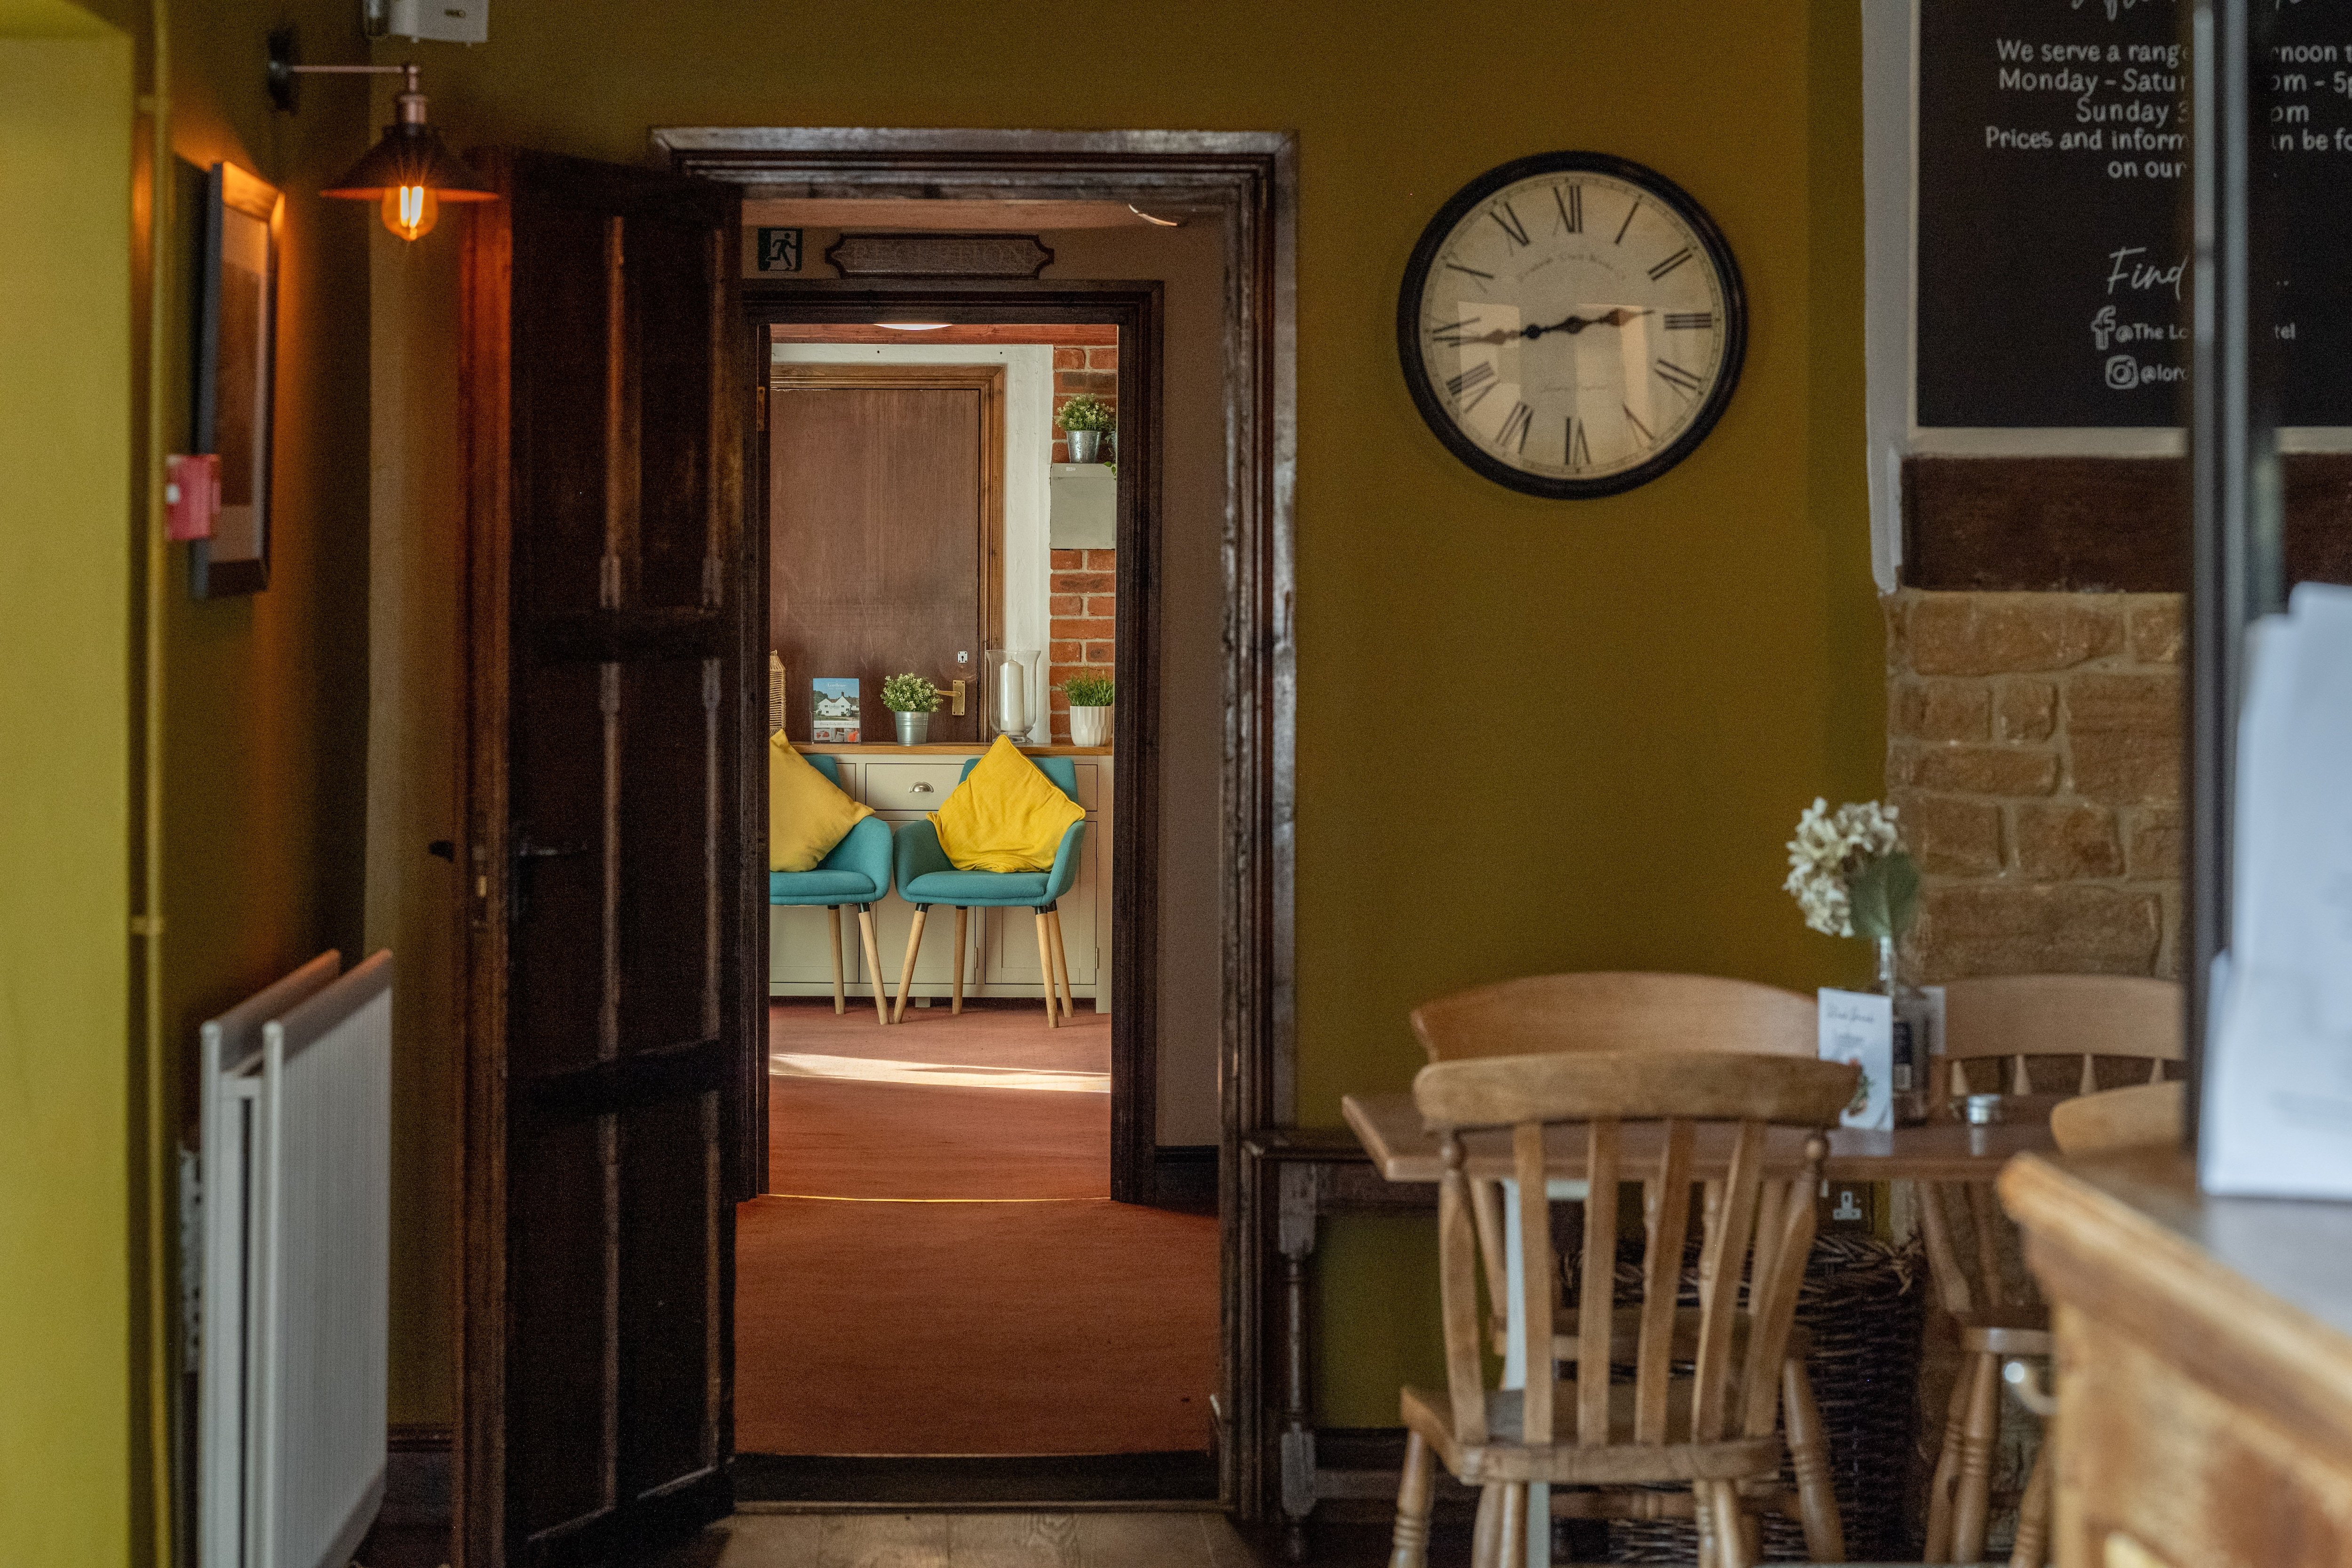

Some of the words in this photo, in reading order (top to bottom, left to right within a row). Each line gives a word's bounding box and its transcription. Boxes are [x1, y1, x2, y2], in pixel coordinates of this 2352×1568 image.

[1996, 38, 2034, 63] We
[2041, 43, 2101, 63] serve
[2106, 44, 2121, 63] a
[1999, 67, 2098, 97] Monday
[2075, 96, 2169, 129] Sunday
[1985, 125, 2054, 150] Prices
[2059, 128, 2103, 151] and
[2302, 128, 2329, 151] be
[2107, 160, 2139, 179] on
[2106, 246, 2189, 301] Find
[2115, 322, 2164, 343] @The
